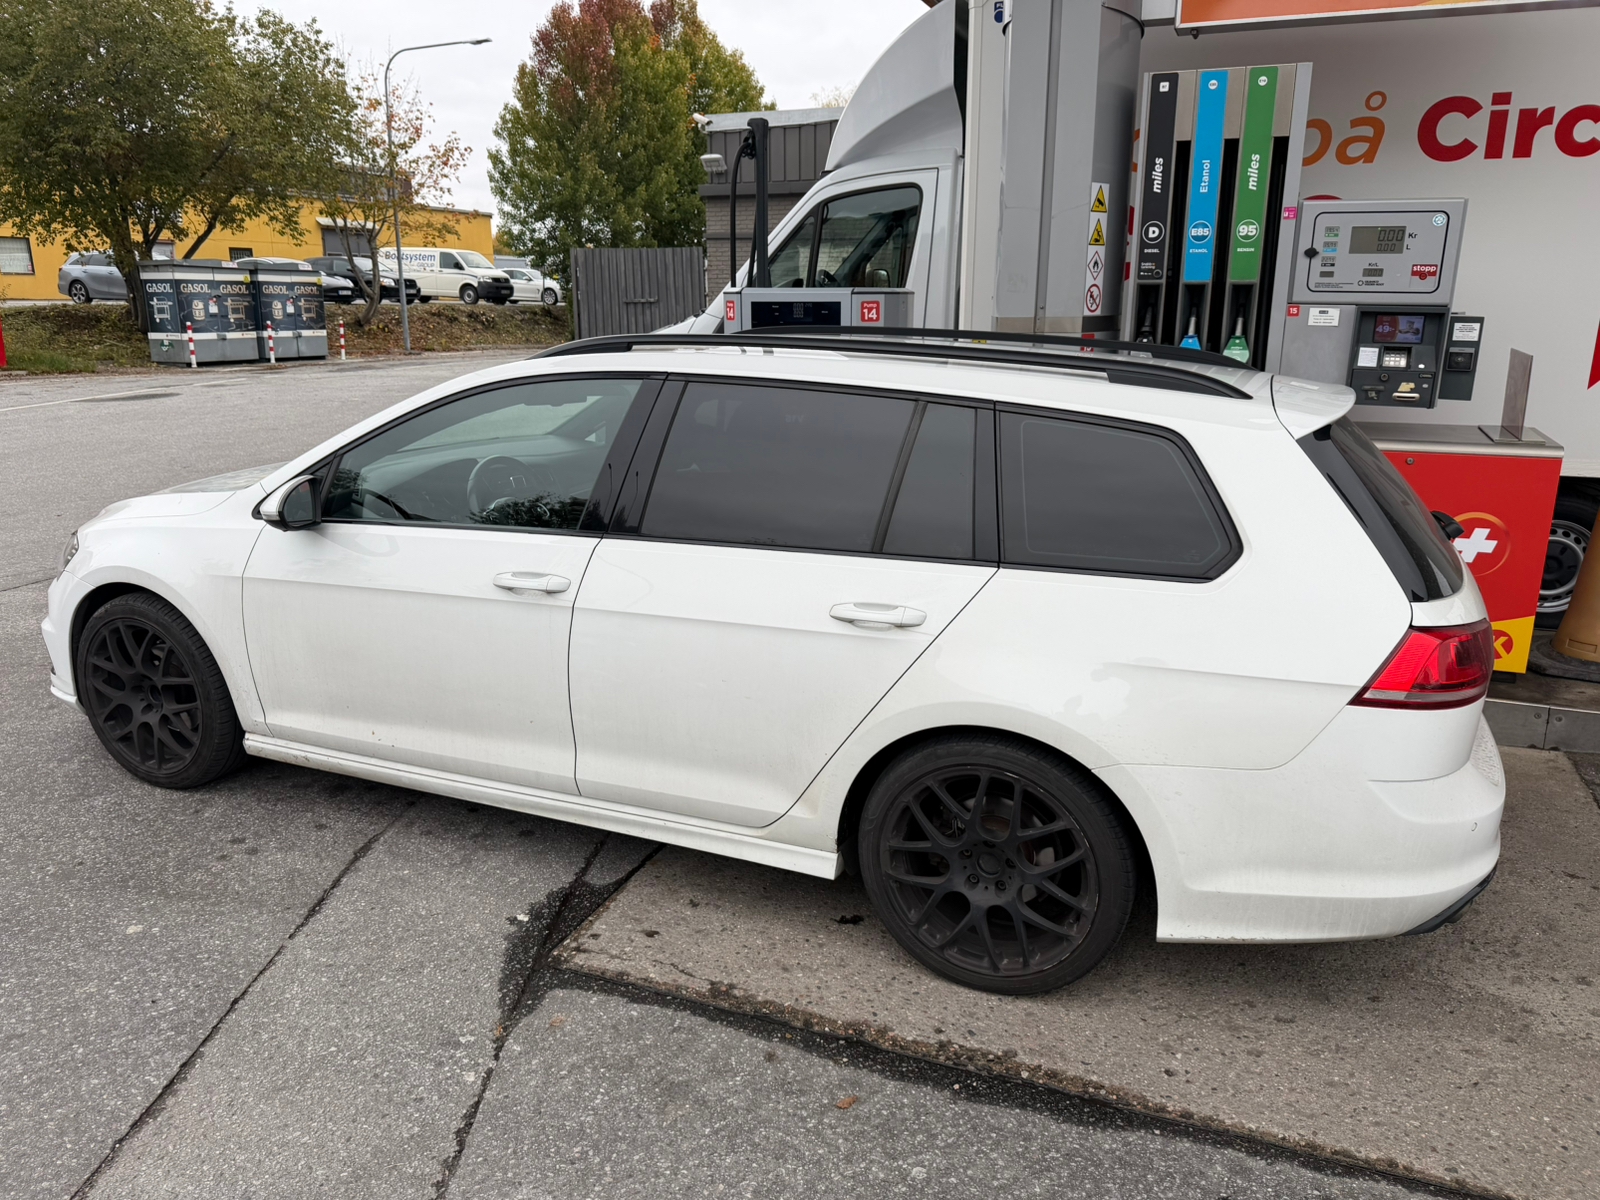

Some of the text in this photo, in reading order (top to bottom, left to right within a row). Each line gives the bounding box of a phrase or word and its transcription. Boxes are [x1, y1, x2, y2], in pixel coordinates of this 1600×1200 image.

[1417, 91, 1600, 162] Circ
[1152, 157, 1164, 193] miles
[1199, 160, 1211, 193] Etanol
[1247, 153, 1261, 191] miles
[1148, 226, 1160, 238] D
[1190, 228, 1210, 236] E85
[1238, 225, 1257, 236] 95
[385, 251, 436, 263] Botsystem
[1412, 265, 1437, 273] stopp
[146, 283, 173, 293] GASOL
[180, 283, 211, 294] GASOL
[220, 284, 249, 294] GASOL
[262, 285, 289, 295] GASOL
[294, 285, 319, 295] GASOL
[726, 307, 734, 319] 14
[862, 309, 878, 320] 14
